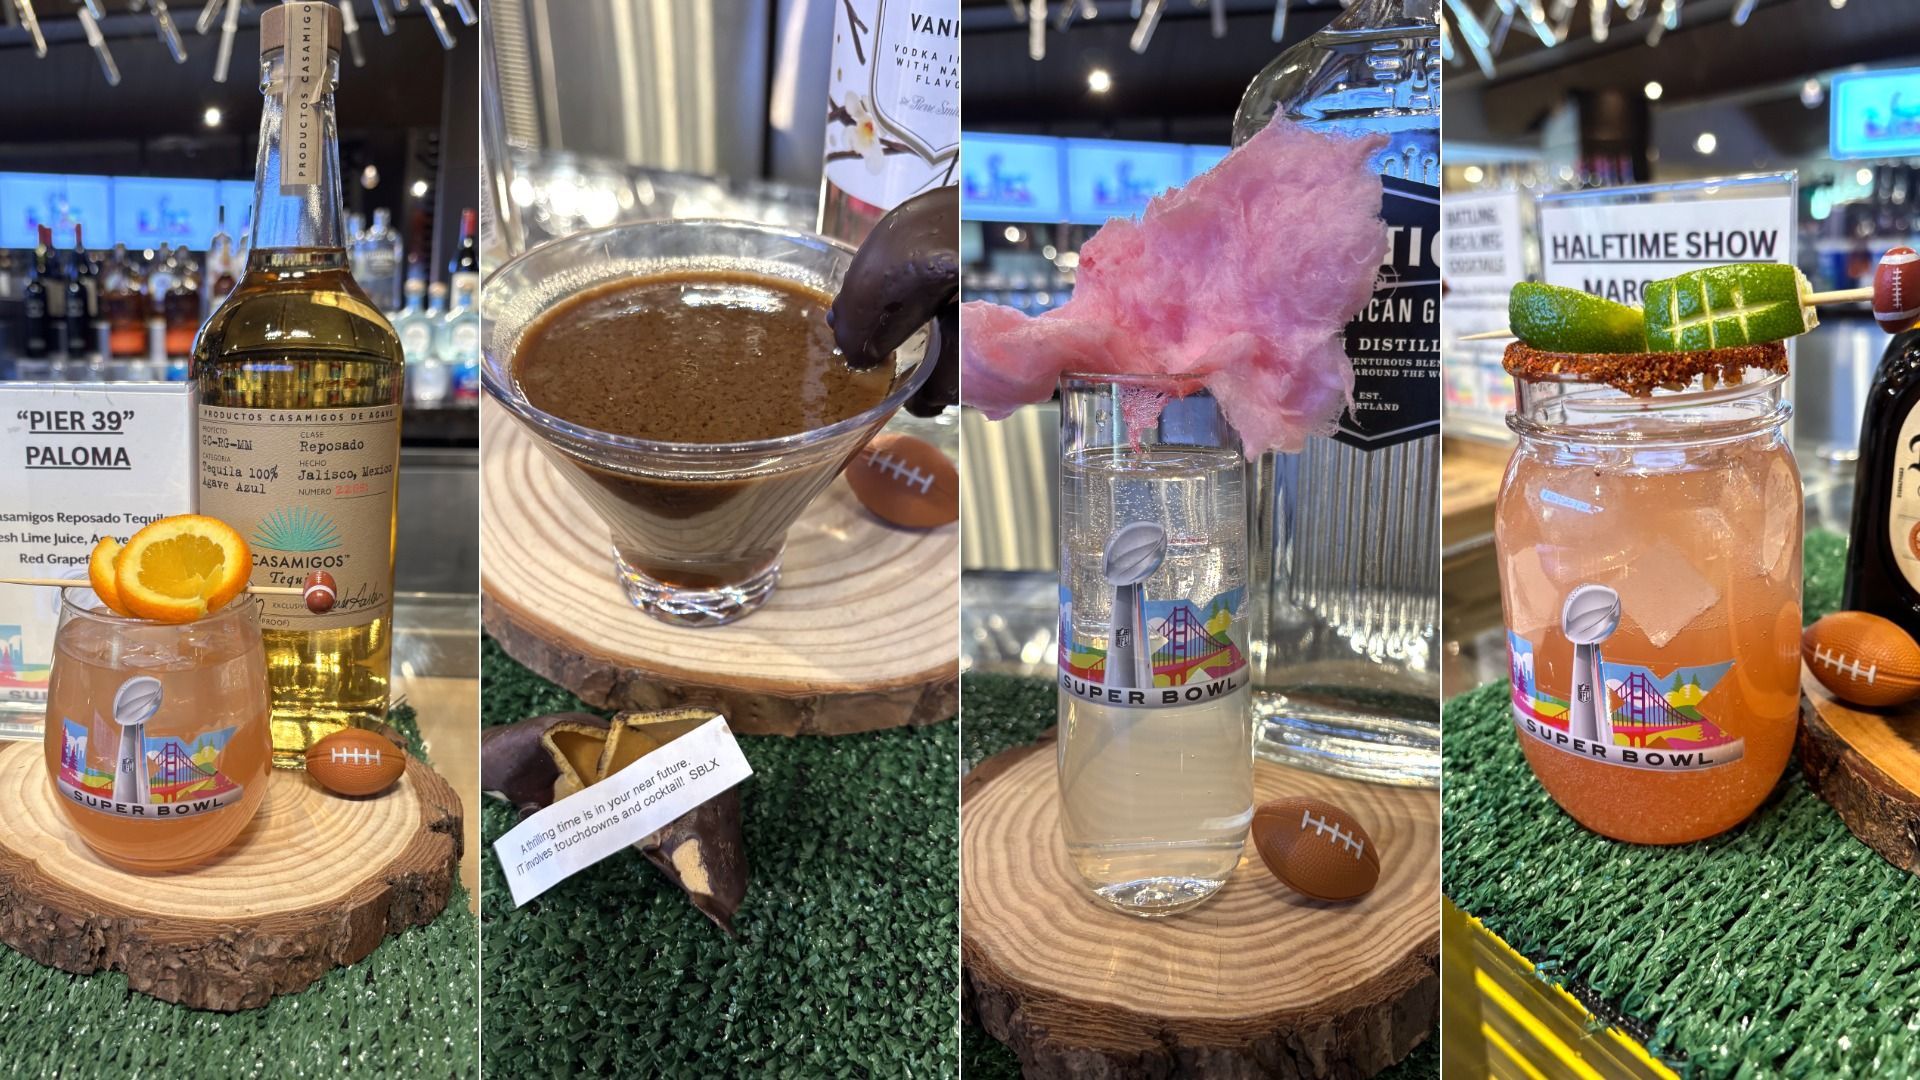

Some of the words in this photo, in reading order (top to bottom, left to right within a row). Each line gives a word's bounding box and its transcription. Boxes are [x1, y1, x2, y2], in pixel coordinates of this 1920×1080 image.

[302, 5, 311, 83] CASAMIGO
[895, 44, 937, 61] VODKA
[896, 57, 929, 72] WITH
[298, 93, 309, 177] PRODUCTOS
[1552, 232, 1679, 260] HALFTIME
[1686, 230, 1778, 258] SHOW
[1422, 298, 1440, 324] G
[1352, 357, 1412, 367] ENTUROUS
[1402, 369, 1425, 378] THE
[1428, 370, 1440, 379] W
[1359, 392, 1383, 400] EST.
[1355, 402, 1400, 411] RTLAND
[203, 409, 262, 421] PRODUCTOS
[270, 413, 344, 422] CASAMIGOS
[351, 412, 364, 420] DE
[300, 431, 324, 439] CLASE
[299, 439, 364, 455] Reposado
[25, 446, 131, 467] PALOMA
[299, 459, 327, 467] HECHO
[202, 461, 243, 477] Tequila
[249, 464, 279, 482] 100%
[297, 469, 357, 481] Jalisco,
[361, 464, 393, 477] Mexico
[202, 475, 229, 489] Agave
[235, 482, 266, 494] Azul
[298, 488, 332, 496] NUMERO
[56, 512, 121, 525] Reposado
[123, 513, 169, 526] Tequil
[21, 533, 51, 543] Lime
[54, 533, 88, 545] Juice,
[19, 553, 44, 564] Red
[47, 554, 91, 566] Grapef
[269, 571, 309, 588] Tequ
[1062, 675, 1145, 704] SUPER
[1162, 678, 1237, 704] BOWL
[1526, 718, 1606, 759] SUPER
[1622, 749, 1714, 767] BOWL
[73, 790, 145, 816] SUPER
[157, 798, 224, 816] BOWL
[520, 845, 528, 855] A
[526, 828, 556, 851] thrilling
[557, 816, 581, 833] time
[583, 810, 593, 821] is
[594, 804, 606, 815] in
[607, 790, 631, 811] your
[632, 776, 657, 796] near
[656, 759, 691, 782] future.
[516, 863, 525, 876] IT
[525, 847, 554, 871] involves
[554, 814, 620, 852] touchdowns
[621, 802, 642, 819] and
[643, 776, 686, 807] cocktail!
[689, 757, 721, 781] SBLX
